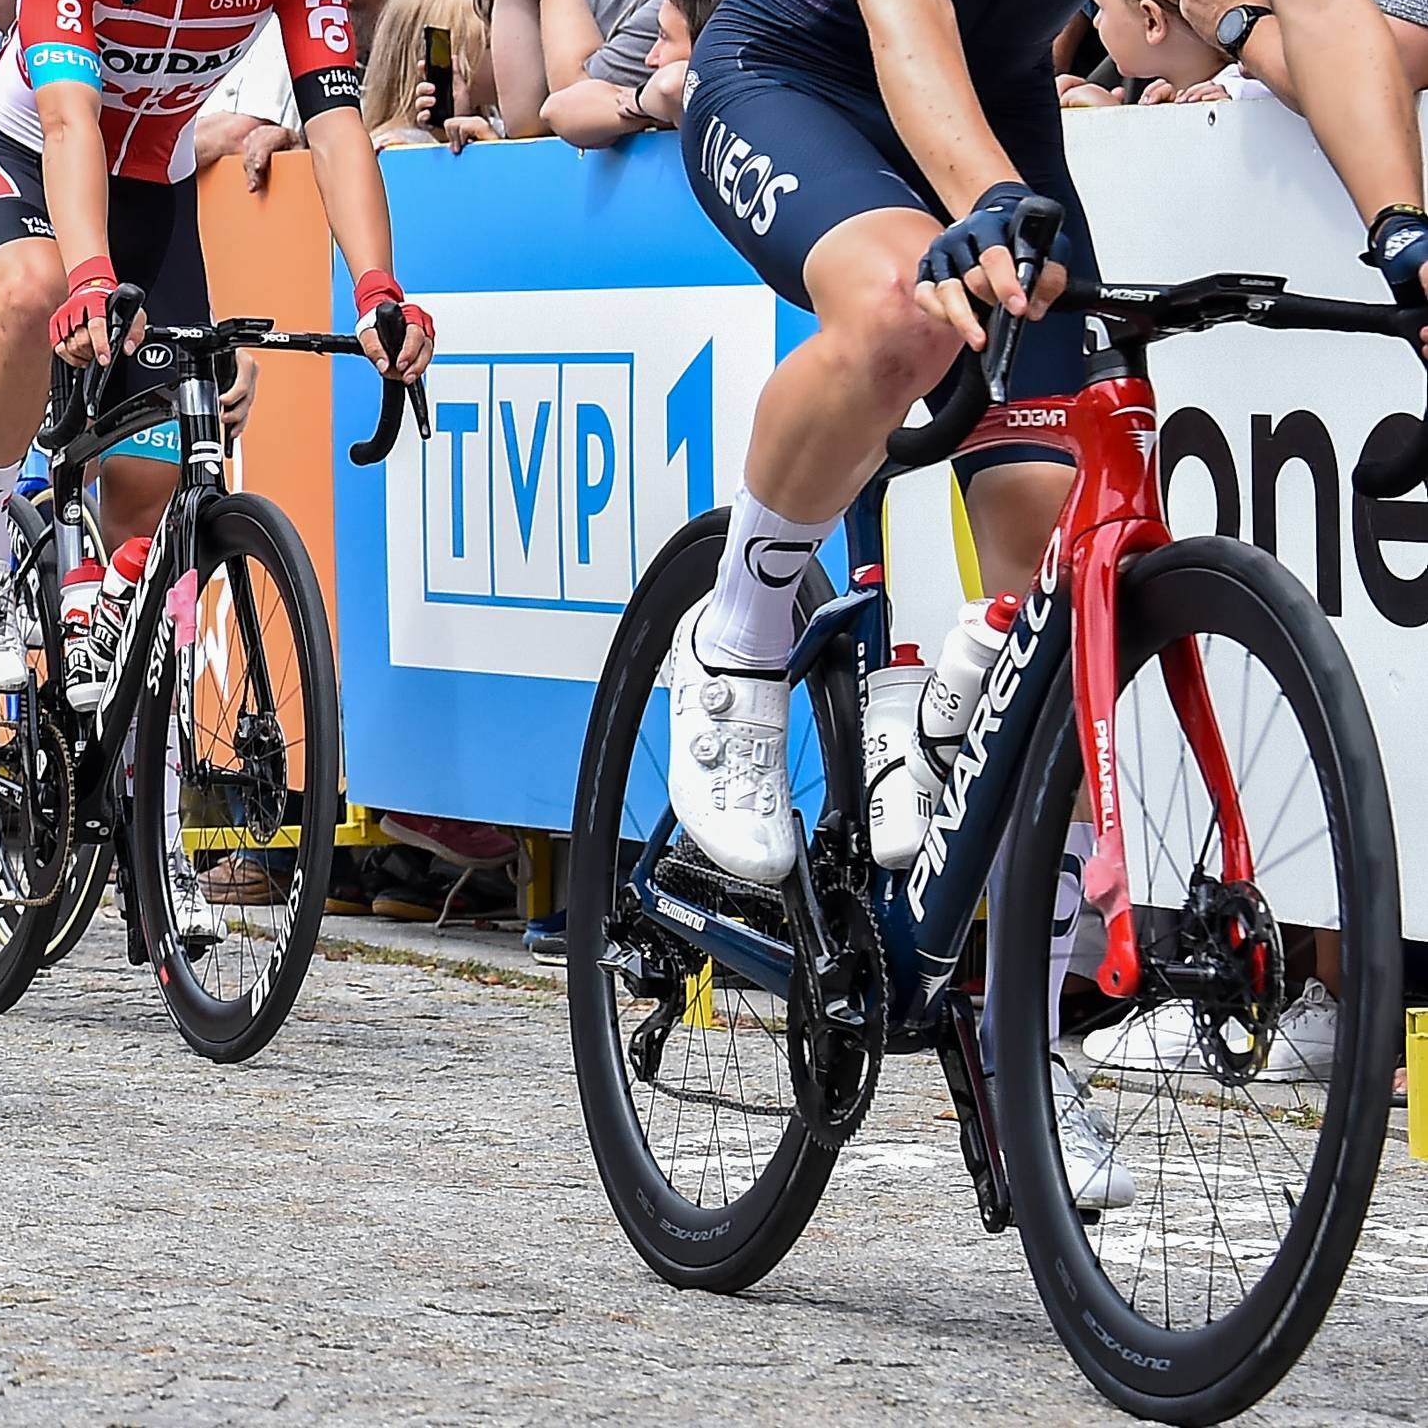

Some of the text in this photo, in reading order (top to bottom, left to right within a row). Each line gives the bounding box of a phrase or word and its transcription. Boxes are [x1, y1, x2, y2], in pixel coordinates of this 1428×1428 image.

[33, 48, 101, 78] dstny
[98, 40, 243, 75] OUDAL
[318, 70, 358, 85] vikin
[701, 115, 799, 236] INEOS
[1007, 409, 1067, 428] DOGMA
[434, 400, 616, 565] TVP
[907, 525, 1063, 923] PINARELLO
[271, 868, 304, 975] SWISS
[656, 898, 706, 932] SHIMANO
